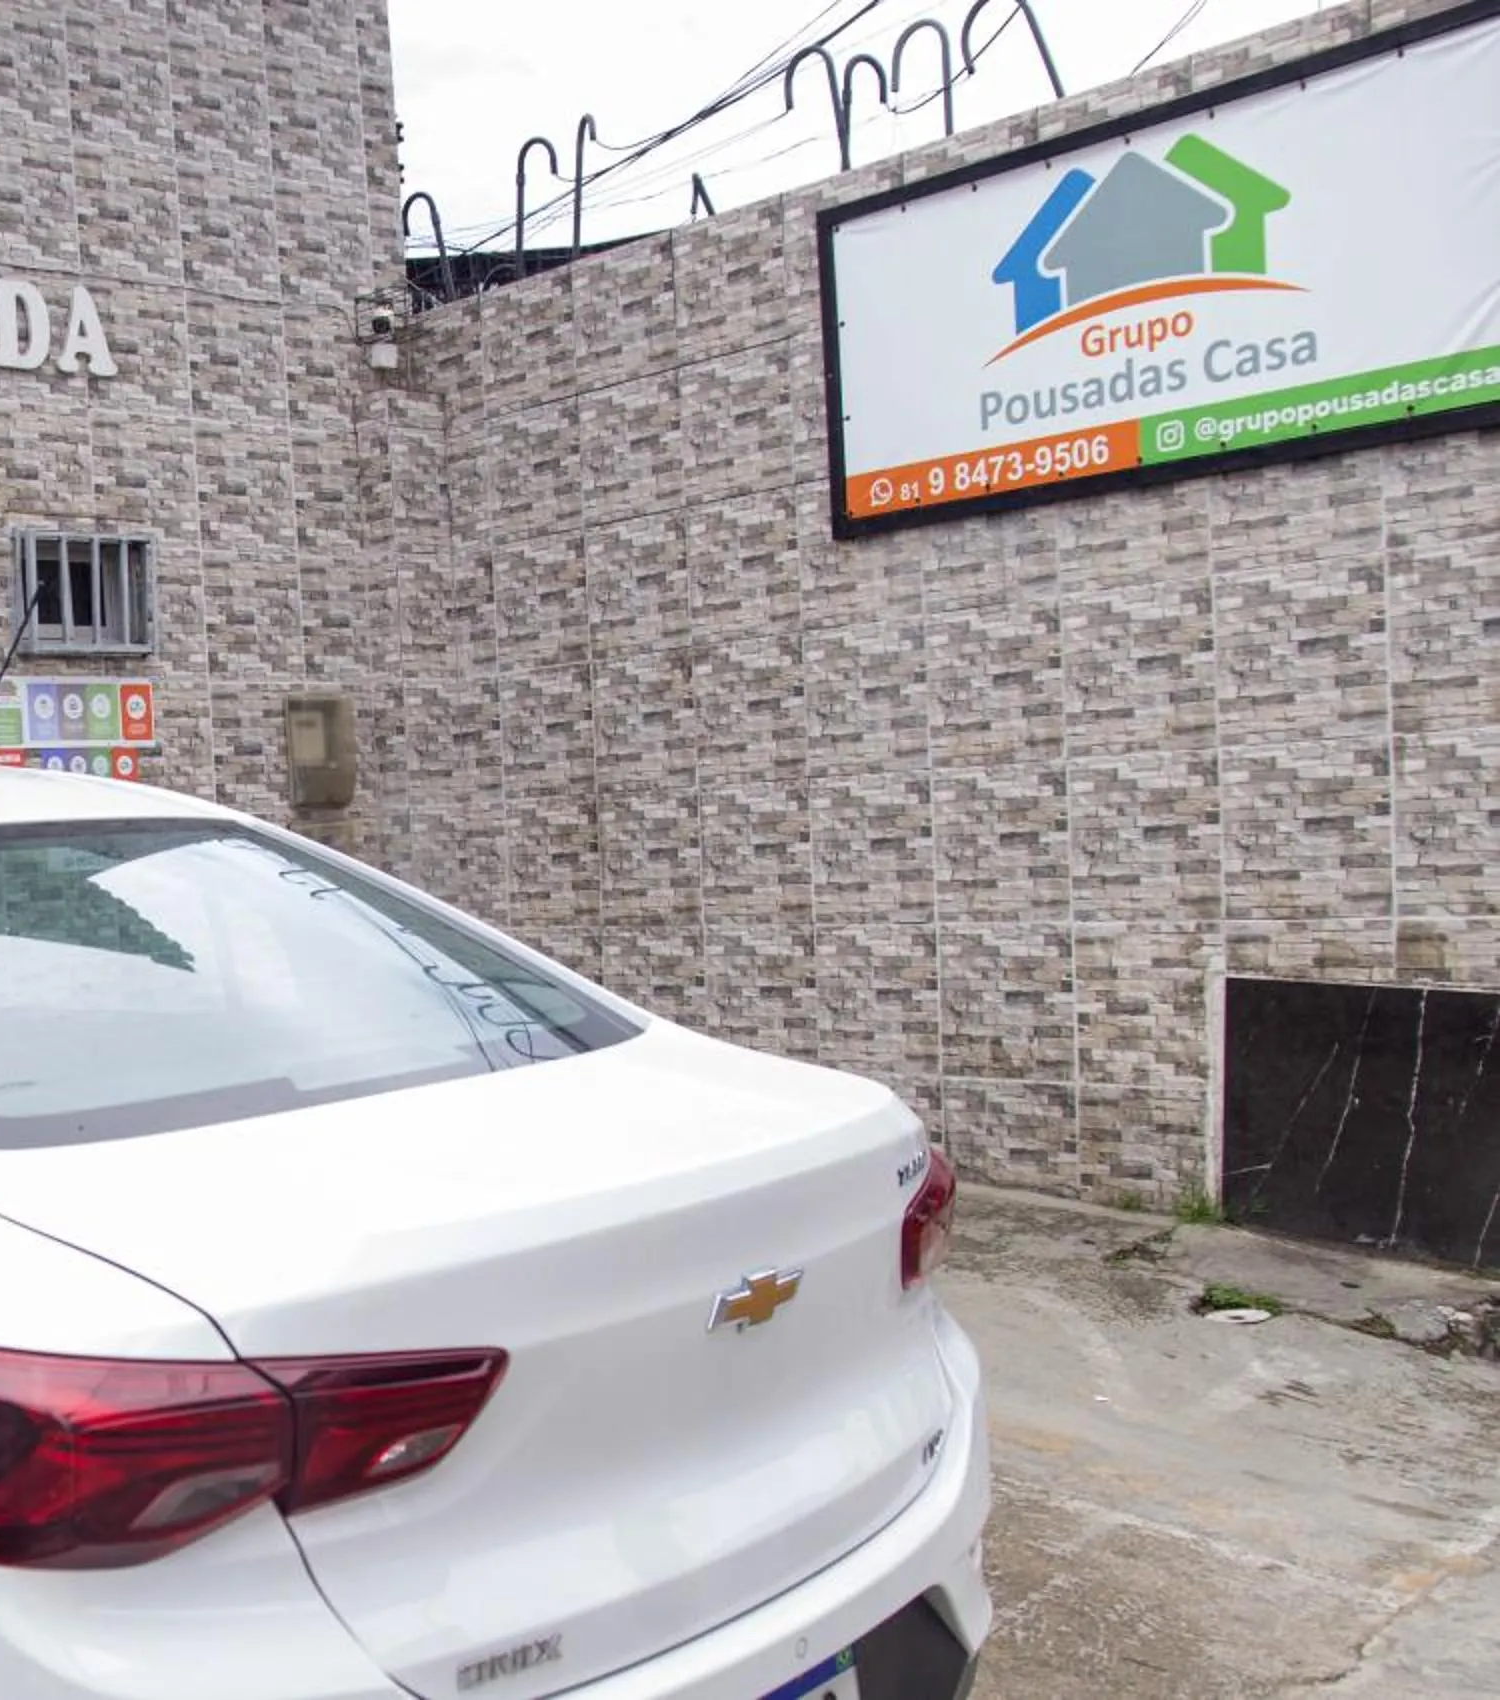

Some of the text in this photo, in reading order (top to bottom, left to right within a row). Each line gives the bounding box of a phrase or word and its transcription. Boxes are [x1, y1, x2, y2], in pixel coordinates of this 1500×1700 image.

[1080, 310, 1194, 358] Grupo
[980, 329, 1318, 431] Pousadas Casa
[1195, 364, 1500, 441] @grupopousadascasa
[900, 434, 1109, 501] 81 9 8473-9506
